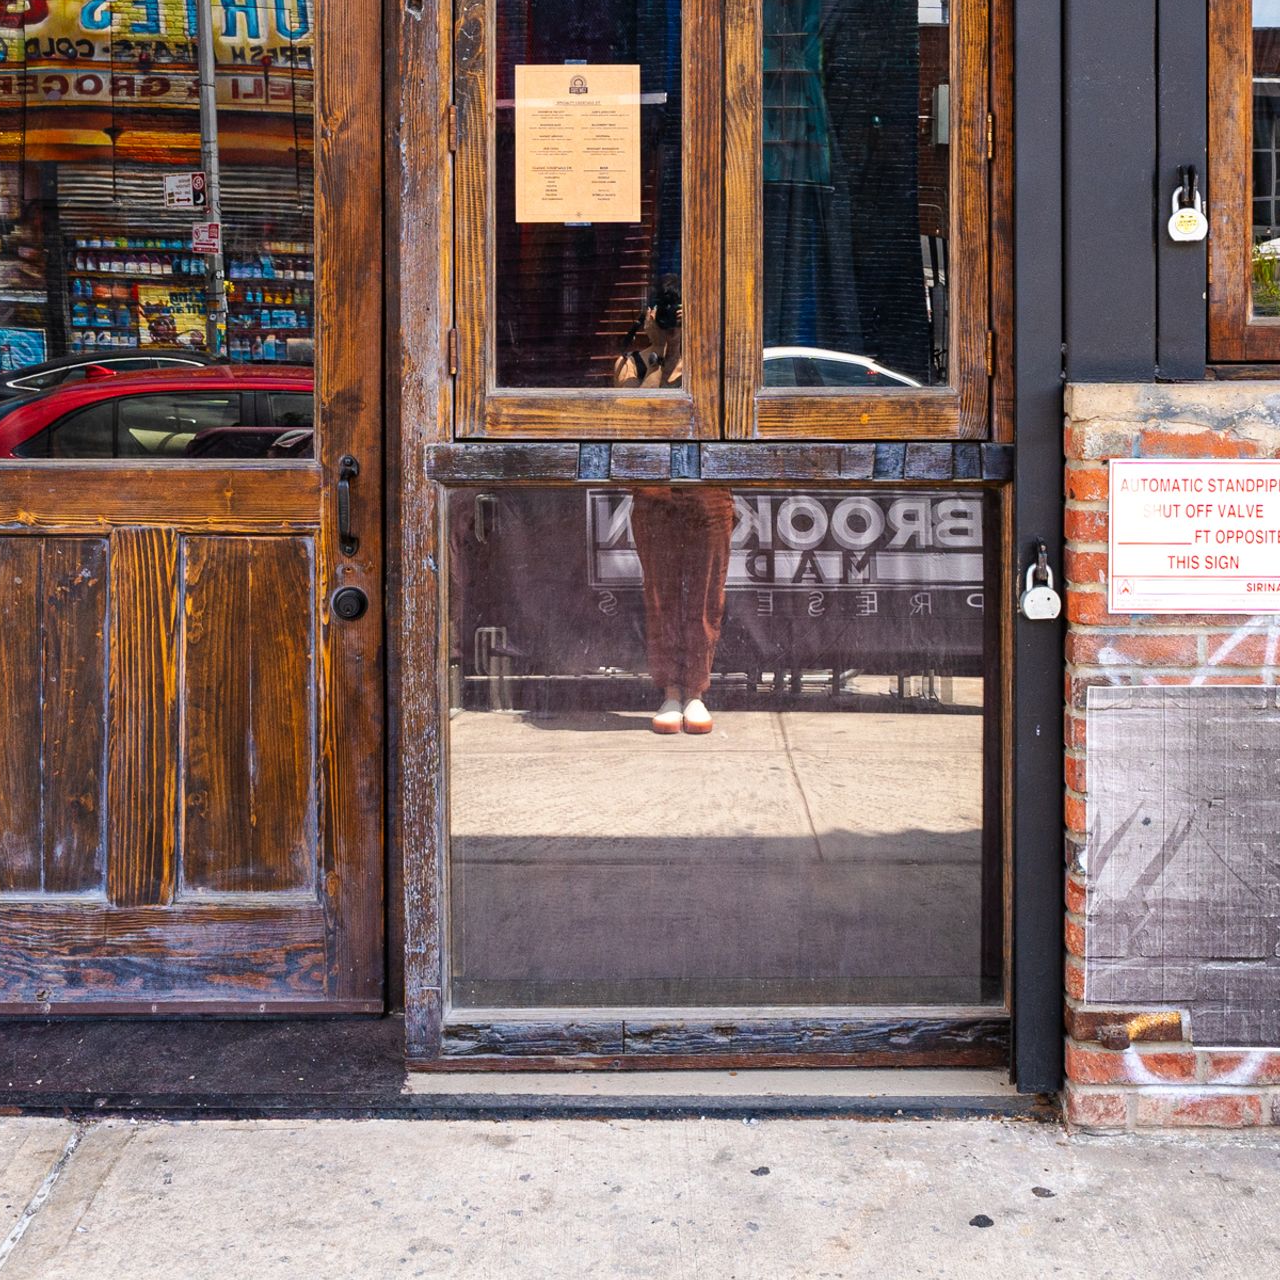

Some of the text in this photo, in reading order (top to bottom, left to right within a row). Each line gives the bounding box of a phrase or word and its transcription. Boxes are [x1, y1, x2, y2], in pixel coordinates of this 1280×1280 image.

[1120, 478, 1204, 493] AUTOMATIC
[1143, 503, 1265, 519] SHUT OFF VALVE
[1194, 529, 1211, 544] FT
[1167, 555, 1241, 570] THIS SIGN
